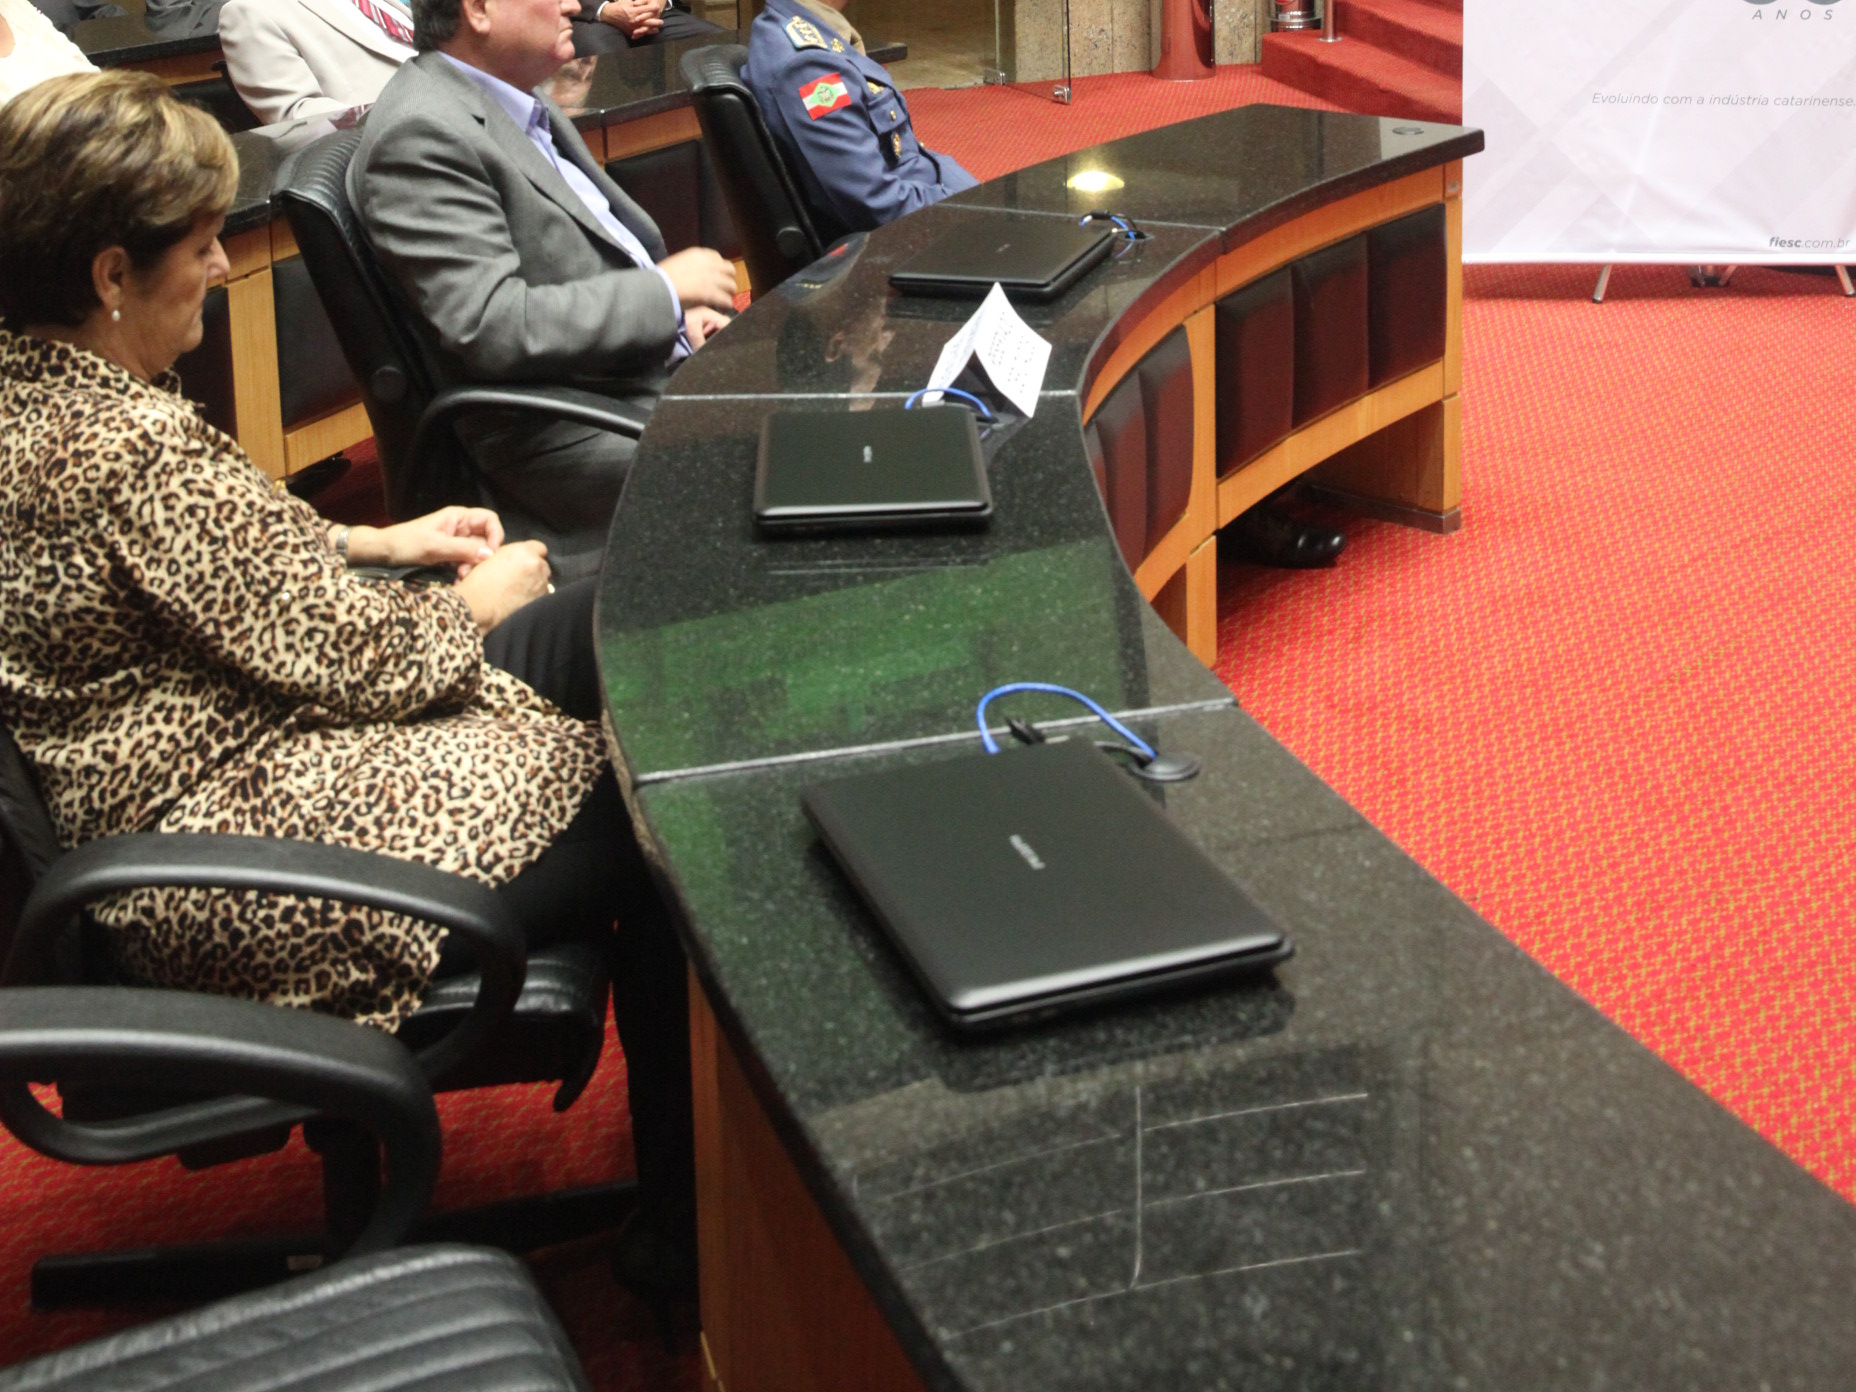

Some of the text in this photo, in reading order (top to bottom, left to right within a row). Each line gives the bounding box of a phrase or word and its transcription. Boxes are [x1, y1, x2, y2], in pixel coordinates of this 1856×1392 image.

[1751, 9, 1833, 21] ANOS
[1591, 93, 1856, 108] Evoluindo com a indústria catarinense.
[1769, 236, 1851, 249] fiesc.com.br
